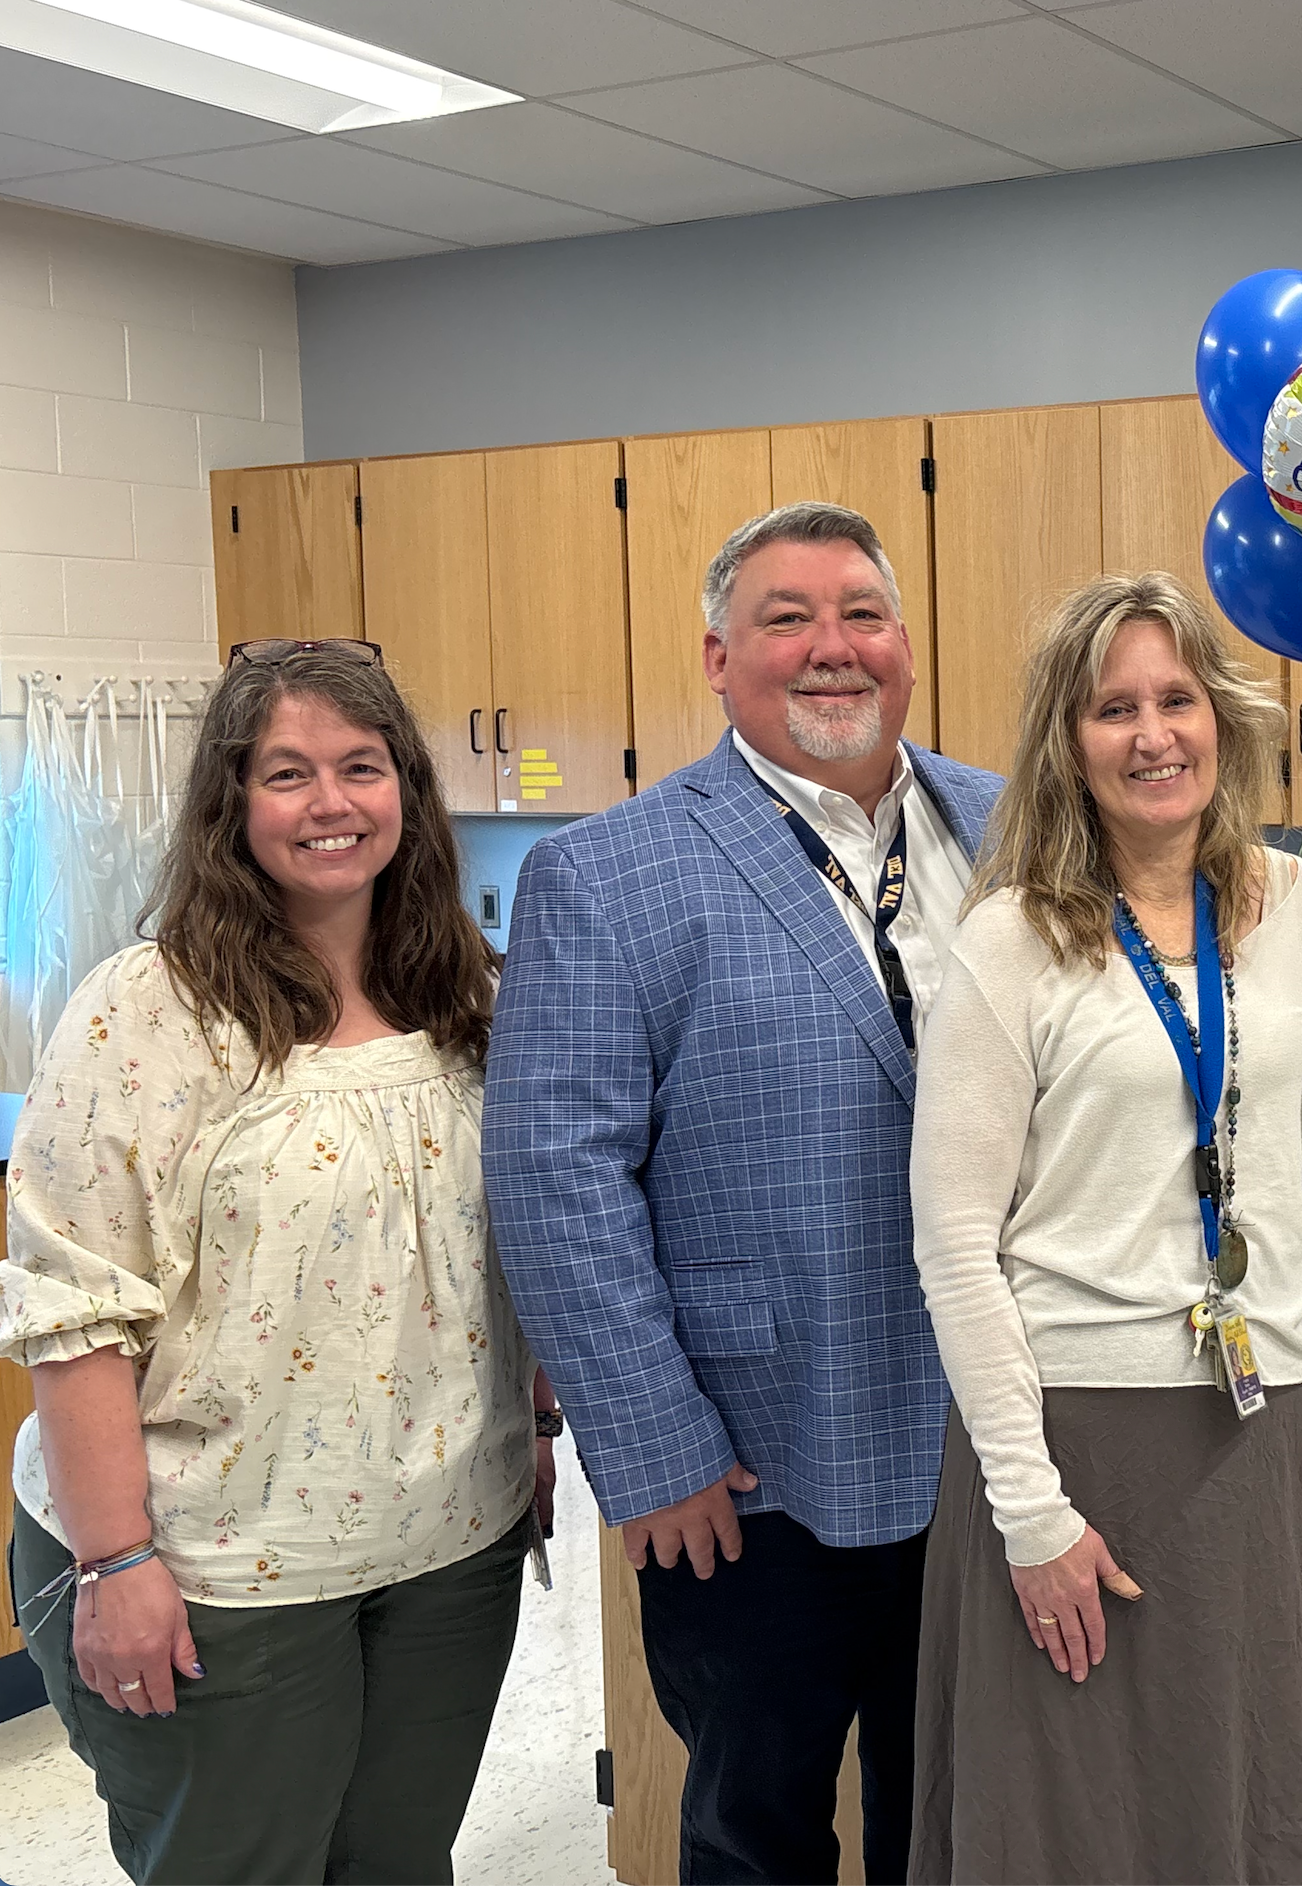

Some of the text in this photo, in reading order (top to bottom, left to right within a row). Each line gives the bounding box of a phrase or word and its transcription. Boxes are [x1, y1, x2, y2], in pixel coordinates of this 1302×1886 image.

[878, 854, 904, 909] DEL VAL
[1139, 963, 1177, 1023] DEL VAL
